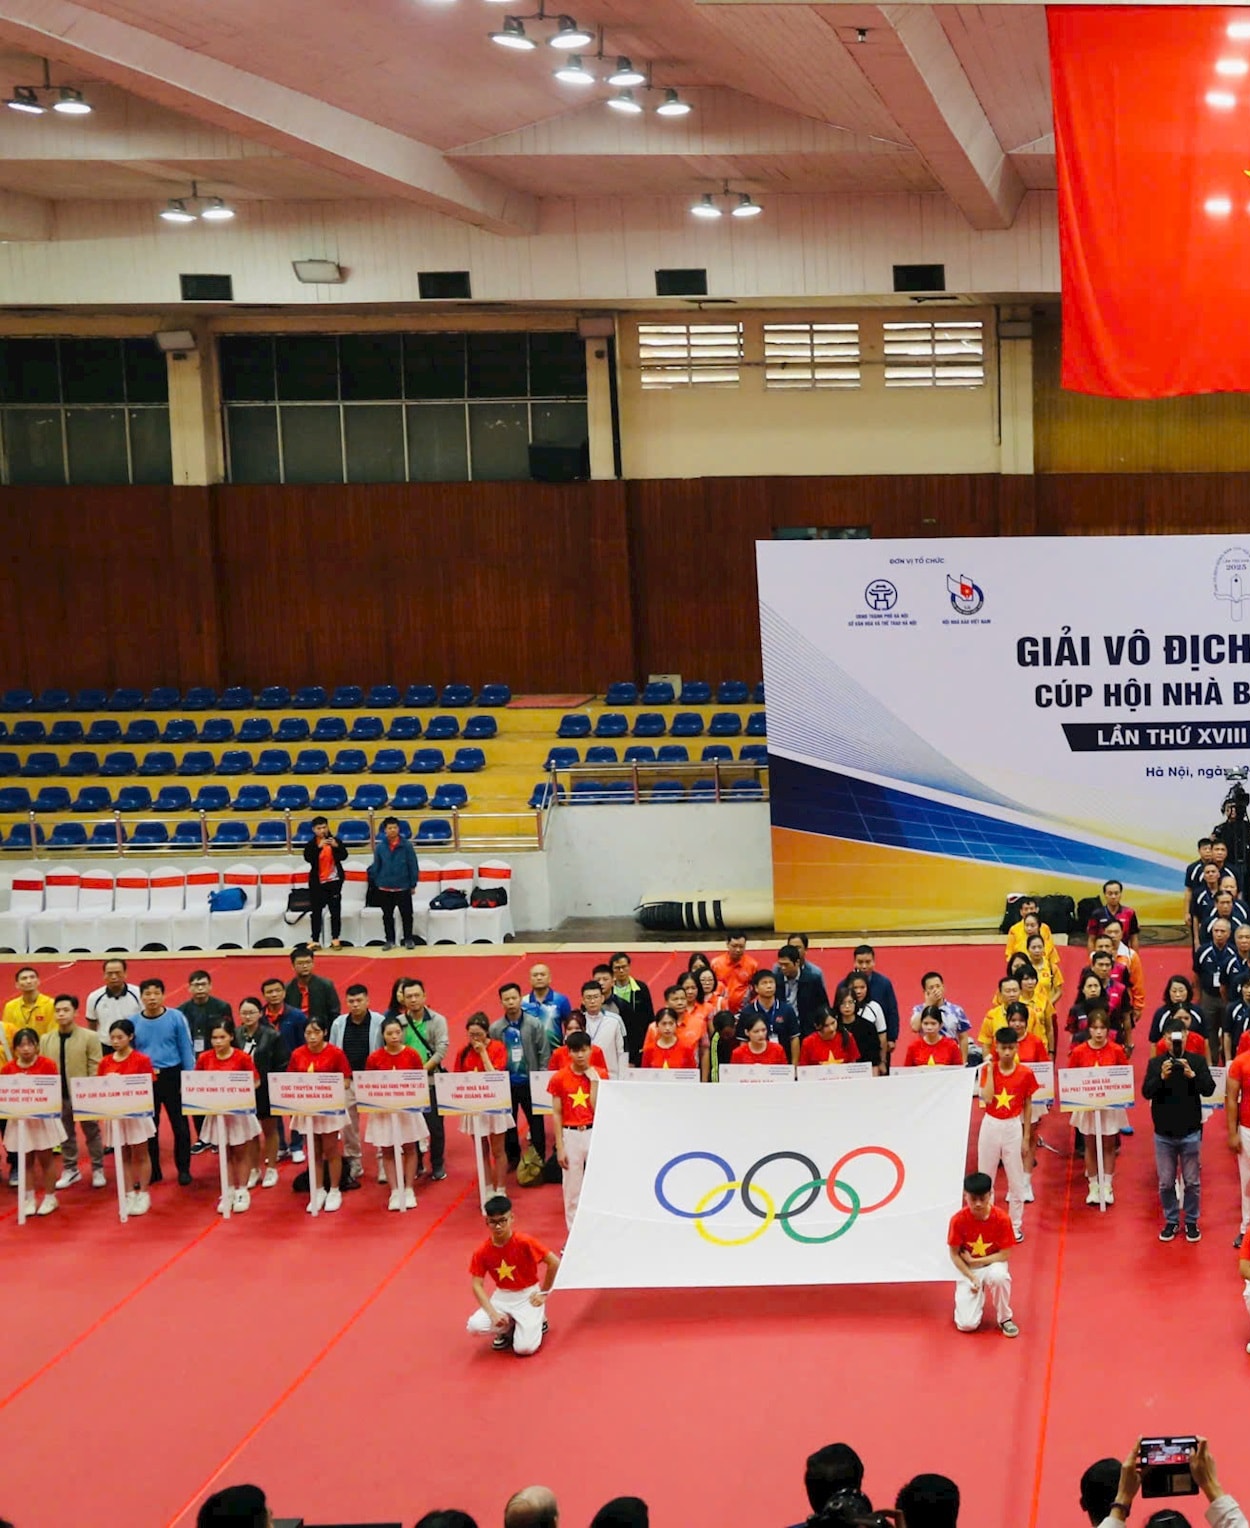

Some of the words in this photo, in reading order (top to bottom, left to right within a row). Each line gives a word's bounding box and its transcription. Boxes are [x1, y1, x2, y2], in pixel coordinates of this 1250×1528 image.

[1016, 626, 1090, 667] GIẢI
[1104, 628, 1150, 666] VÔ
[1163, 634, 1250, 672] ĐỊCH
[1035, 679, 1093, 708] CÚP
[1104, 678, 1151, 712] HỘI
[1162, 676, 1223, 706] NHÀ
[1097, 724, 1140, 746] LẦN
[1146, 724, 1192, 745] THỨ
[1198, 727, 1247, 744] XVIII
[1146, 766, 1164, 777] Hà
[1168, 766, 1193, 780] Nội,
[1198, 765, 1228, 778] ngà
